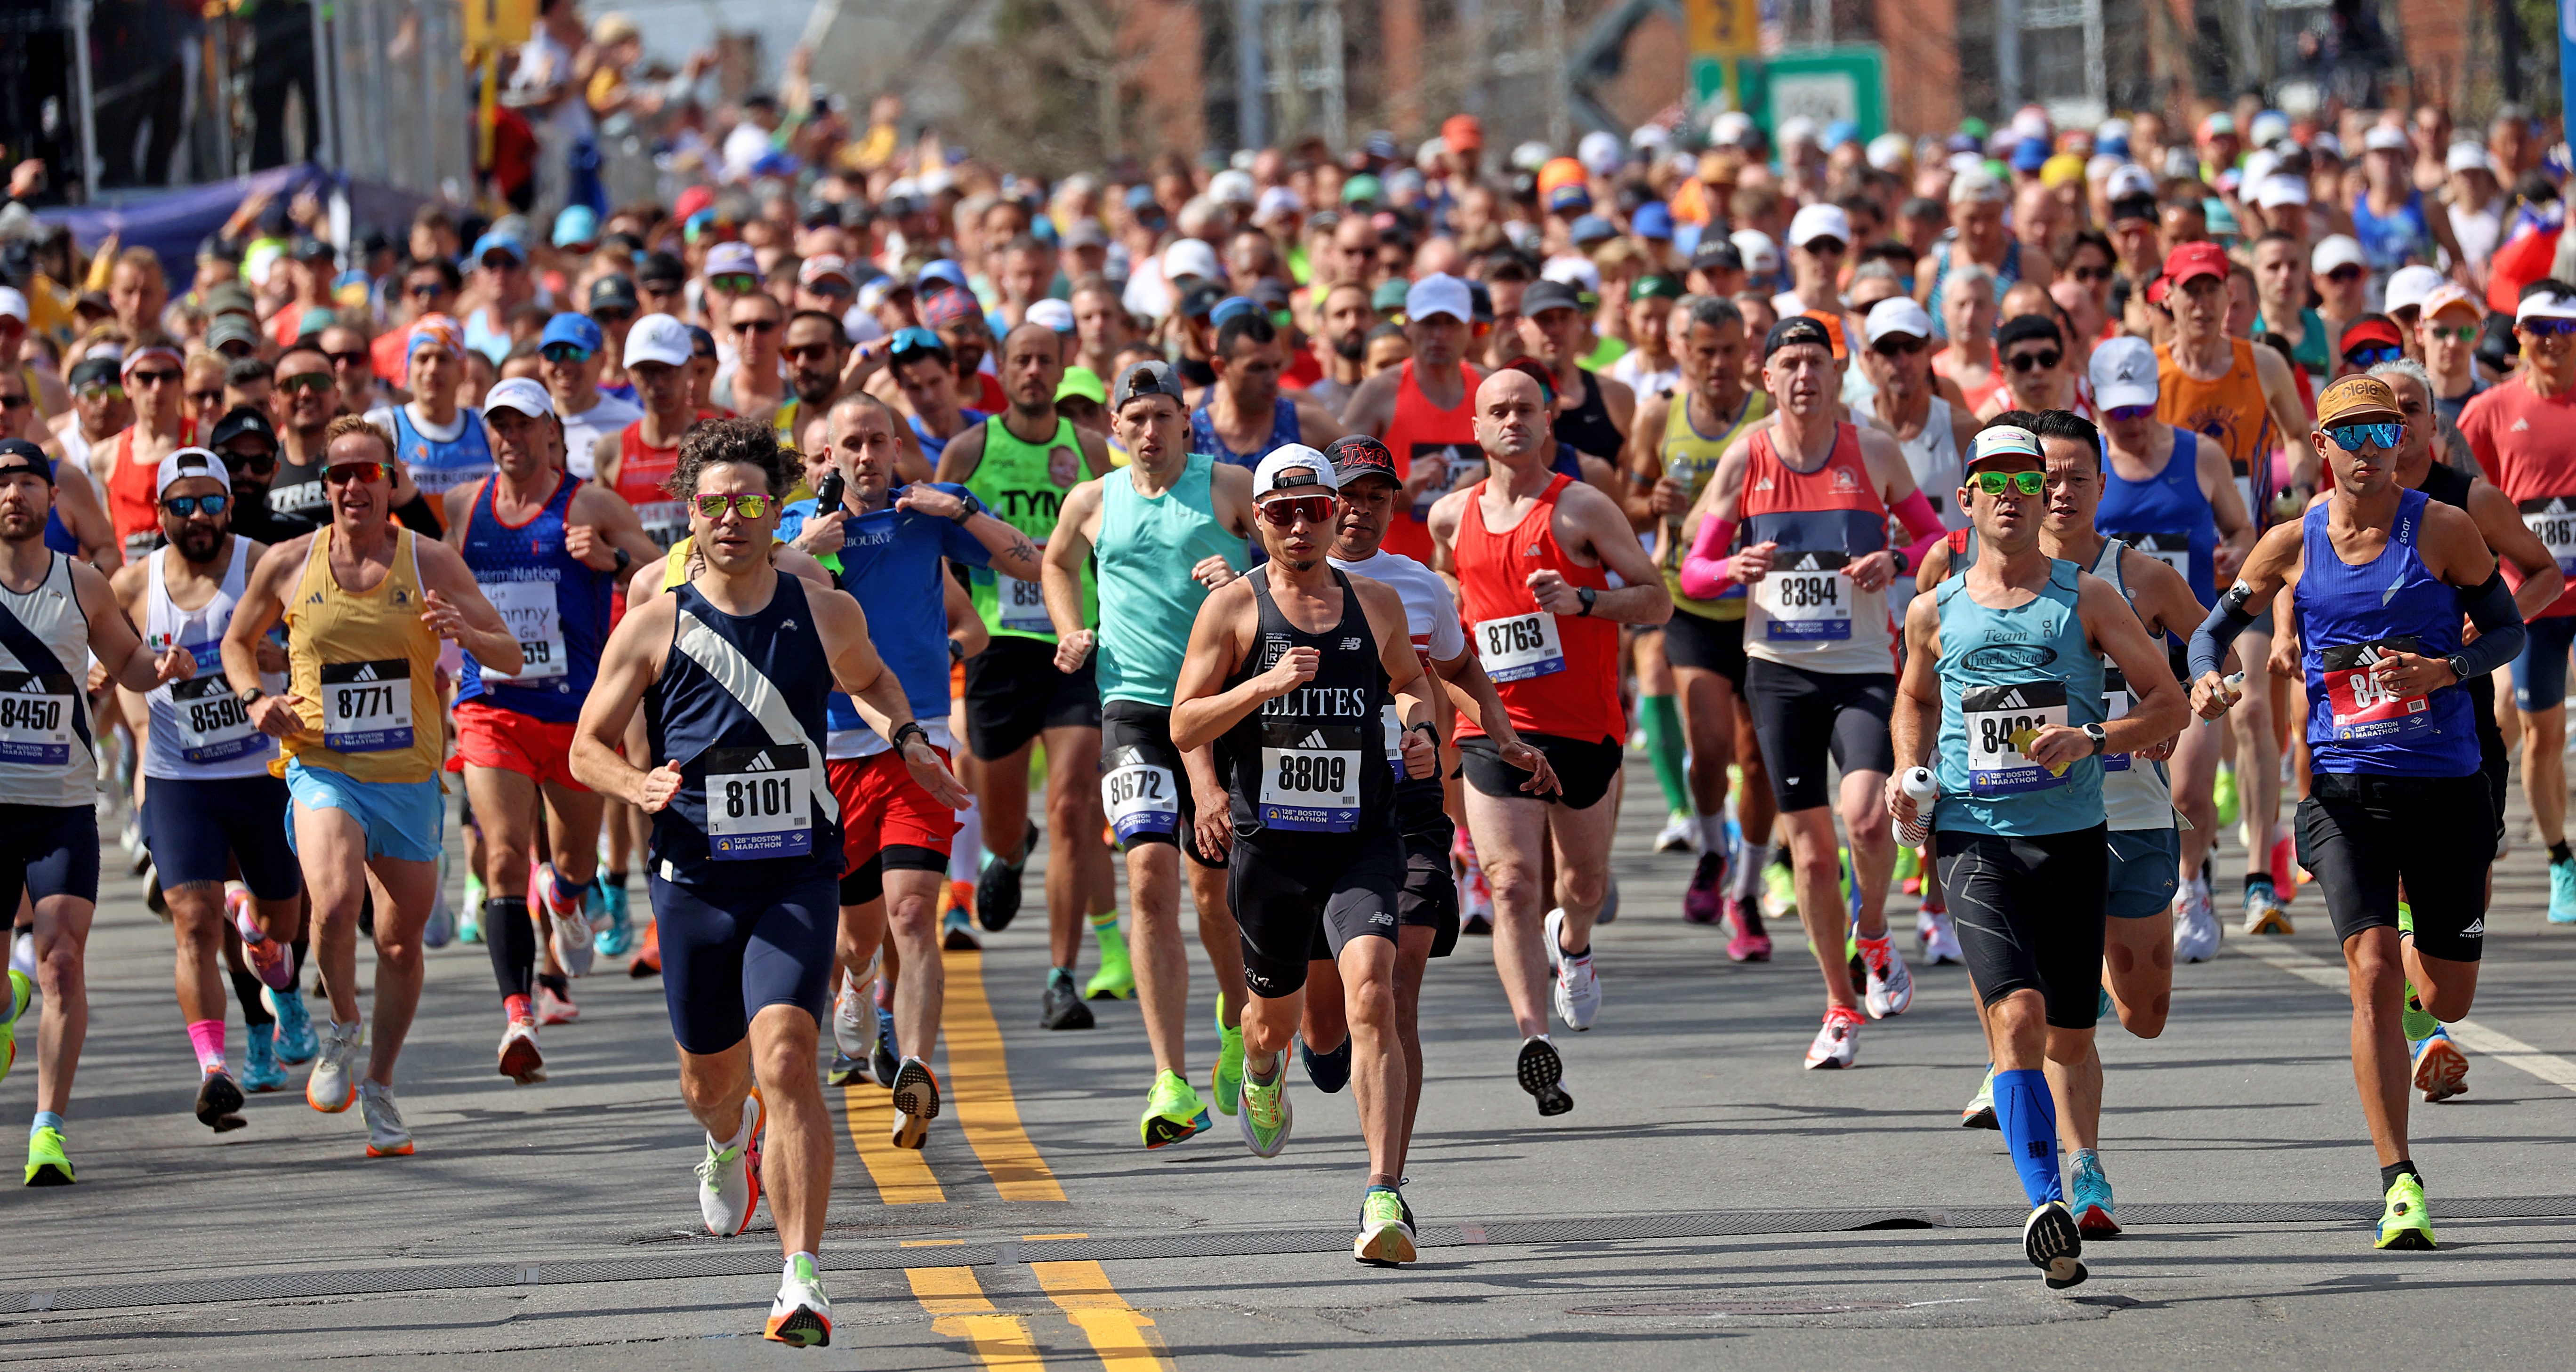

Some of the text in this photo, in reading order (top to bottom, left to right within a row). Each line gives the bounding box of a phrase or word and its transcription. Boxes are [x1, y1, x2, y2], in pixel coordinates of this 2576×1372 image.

[2343, 382, 2377, 399] ciele
[2400, 517, 2411, 544] soar
[2534, 519, 2576, 546] 886
[1014, 580, 1044, 606] 89
[1781, 577, 1837, 607] 8394
[1270, 644, 1287, 652] NB
[1488, 618, 1544, 656] 8763
[1983, 630, 2028, 643] Team
[1969, 649, 2051, 668] Track Shack
[2350, 669, 2401, 708] 84
[1, 698, 61, 731] 8450
[190, 696, 249, 733] 8590
[338, 686, 393, 719] 8771
[1261, 688, 1365, 717] ELITES
[2356, 729, 2399, 738] MARATHON
[2369, 721, 2398, 730] BOSTON
[1279, 755, 1346, 793] 8809
[1991, 776, 2037, 786] MARATHON
[2006, 770, 2037, 778] BOSTON
[726, 778, 791, 818] 8101
[1111, 770, 1162, 806] 8672
[1266, 793, 1269, 801] 1
[714, 824, 718, 832] 1
[1282, 815, 1327, 823] MARATHON
[735, 842, 782, 850] MARATHON
